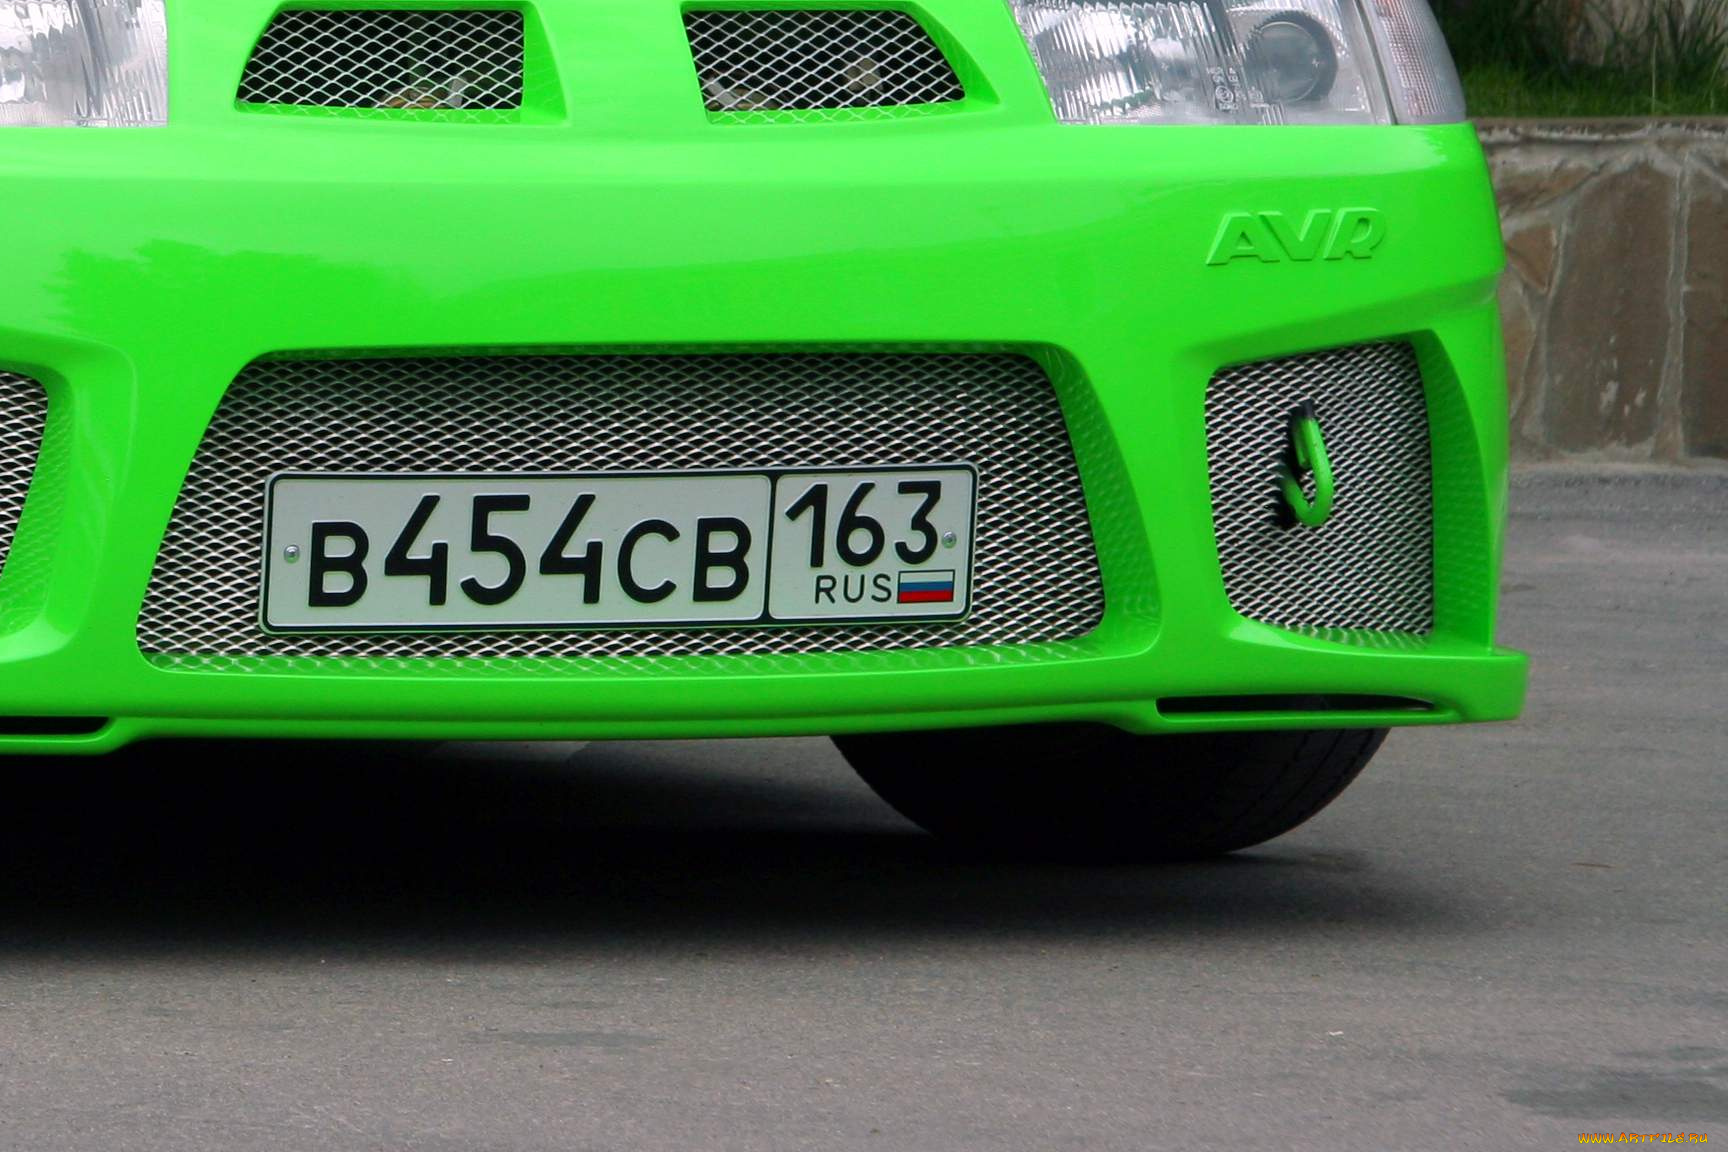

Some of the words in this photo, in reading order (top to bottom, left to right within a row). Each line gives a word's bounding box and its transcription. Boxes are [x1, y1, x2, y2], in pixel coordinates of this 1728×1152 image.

[1205, 207, 1386, 266] AVR
[784, 480, 944, 569] 163
[814, 573, 893, 605] RUS
